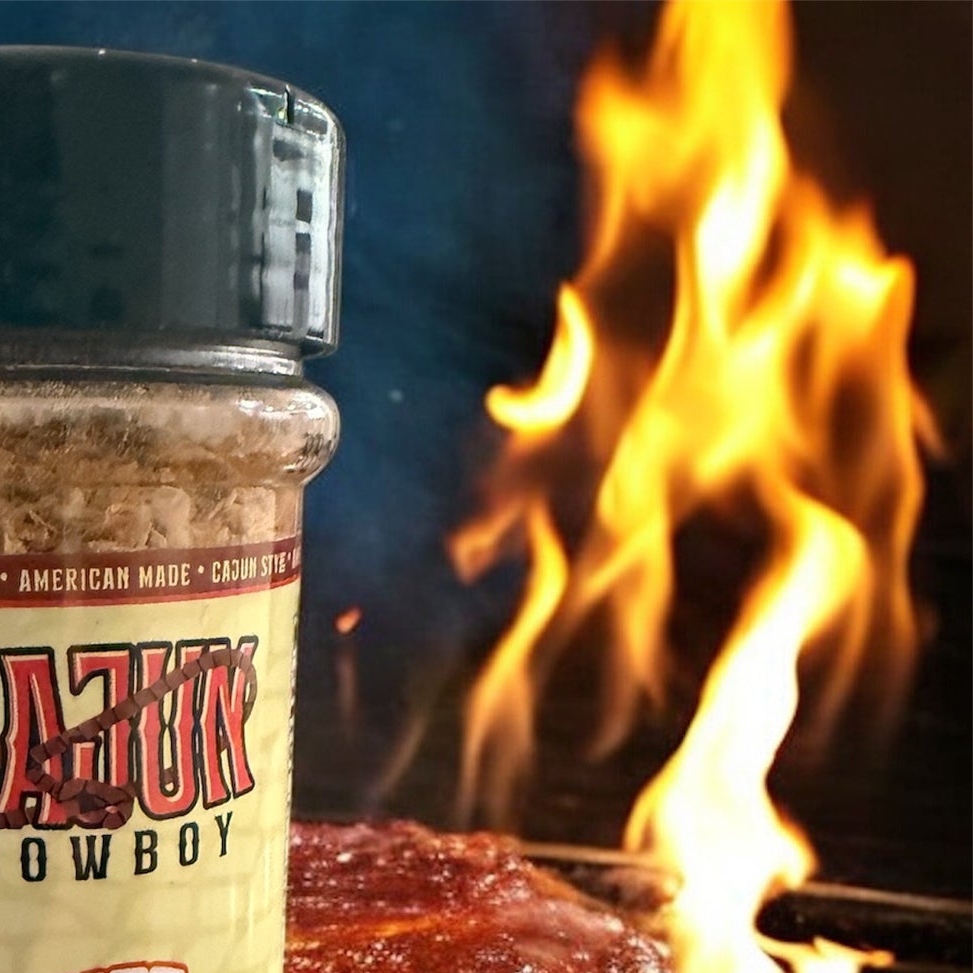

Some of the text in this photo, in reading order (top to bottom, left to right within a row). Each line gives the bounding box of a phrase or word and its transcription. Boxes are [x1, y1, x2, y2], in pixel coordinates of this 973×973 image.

[18, 566, 130, 593] AMERICAN
[138, 562, 191, 589] MADE
[212, 556, 257, 584] CAJUN
